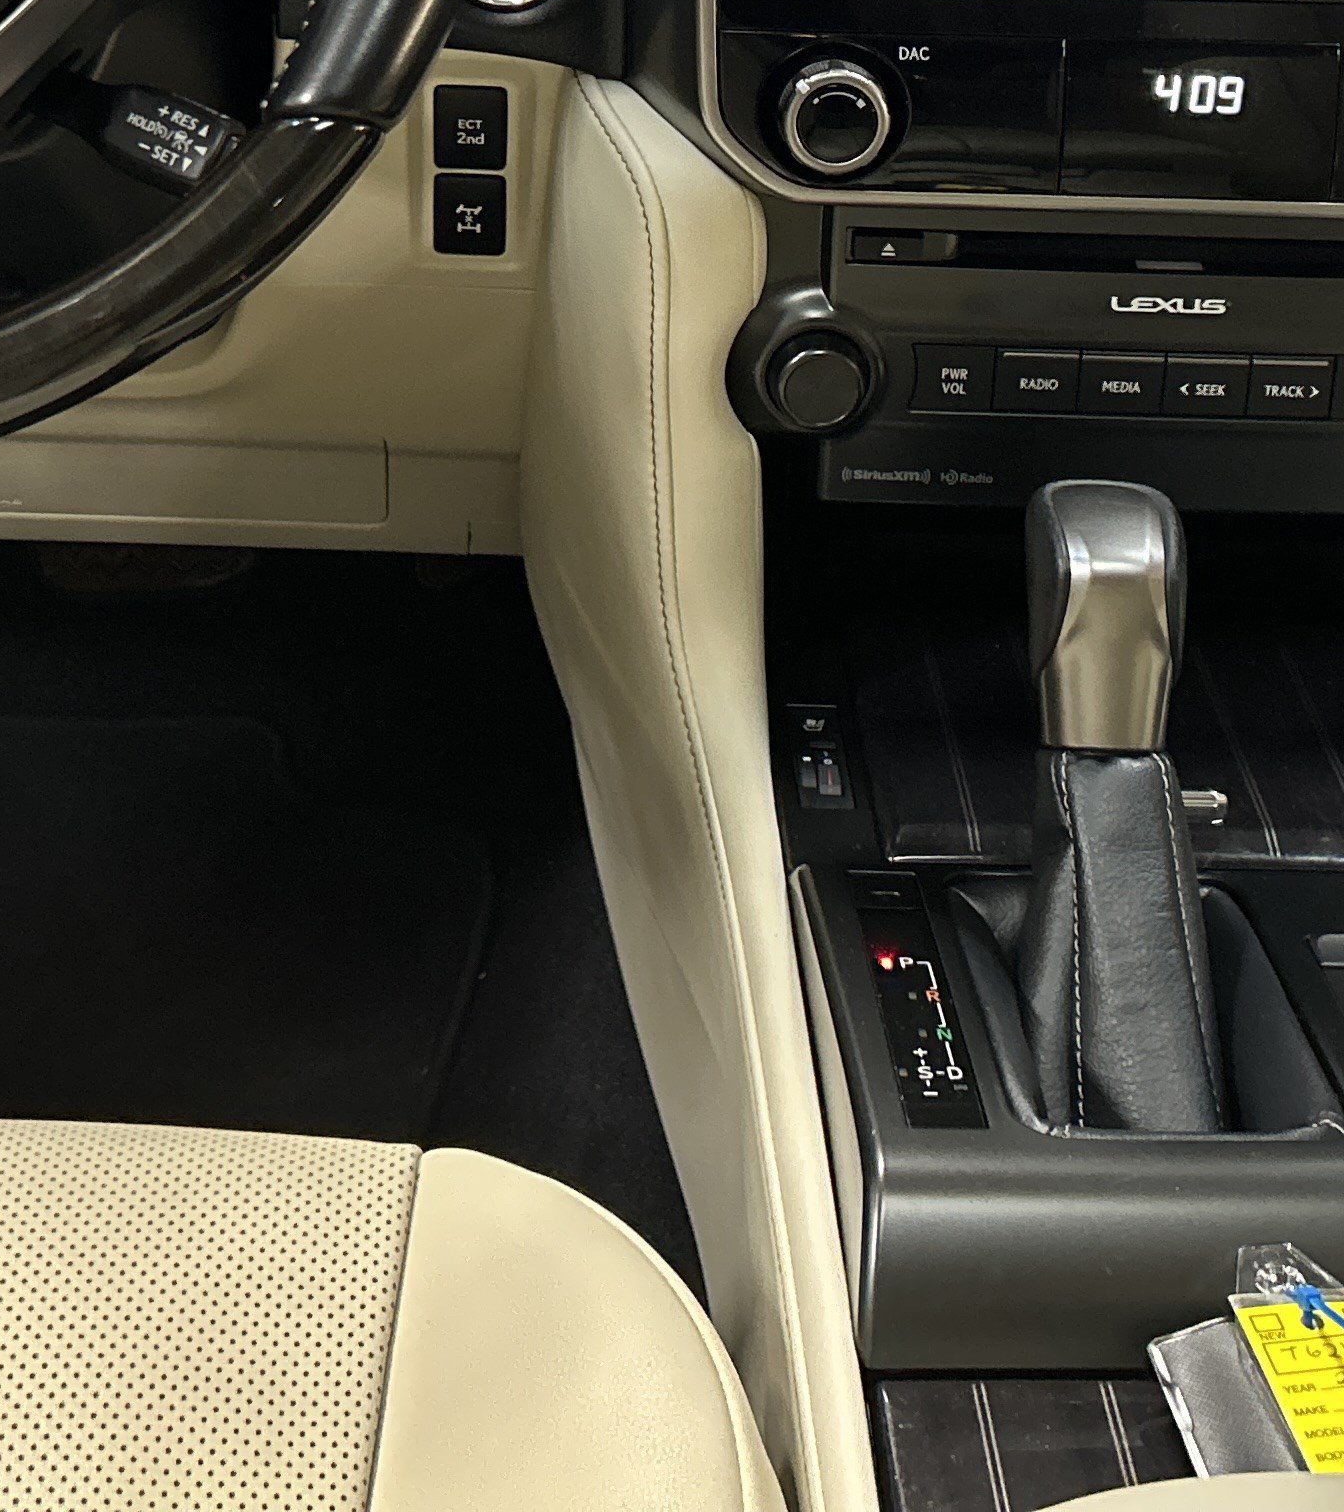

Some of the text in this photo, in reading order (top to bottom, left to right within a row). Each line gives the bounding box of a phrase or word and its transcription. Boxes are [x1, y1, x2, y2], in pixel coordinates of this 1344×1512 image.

[898, 47, 931, 62] DAC
[126, 111, 156, 134] HOLD
[169, 109, 200, 132] RES
[457, 118, 483, 131] ECT
[456, 131, 486, 146] 2nd
[150, 144, 181, 167] SET
[1110, 295, 1228, 315] LEXUS
[941, 367, 969, 381] PWR
[941, 381, 967, 396] VOL
[1019, 377, 1059, 391] RADIO
[1101, 379, 1142, 395] MEDIA
[1194, 383, 1227, 398] SEEK
[1264, 384, 1306, 400] TRACK
[959, 471, 995, 484] Radio
[899, 956, 914, 970] P
[924, 988, 941, 1004] R
[936, 1026, 954, 1042] N
[1258, 1331, 1287, 1342] NEW
[1282, 1382, 1317, 1395] YEAR
[1292, 1404, 1330, 1417] MAKE
